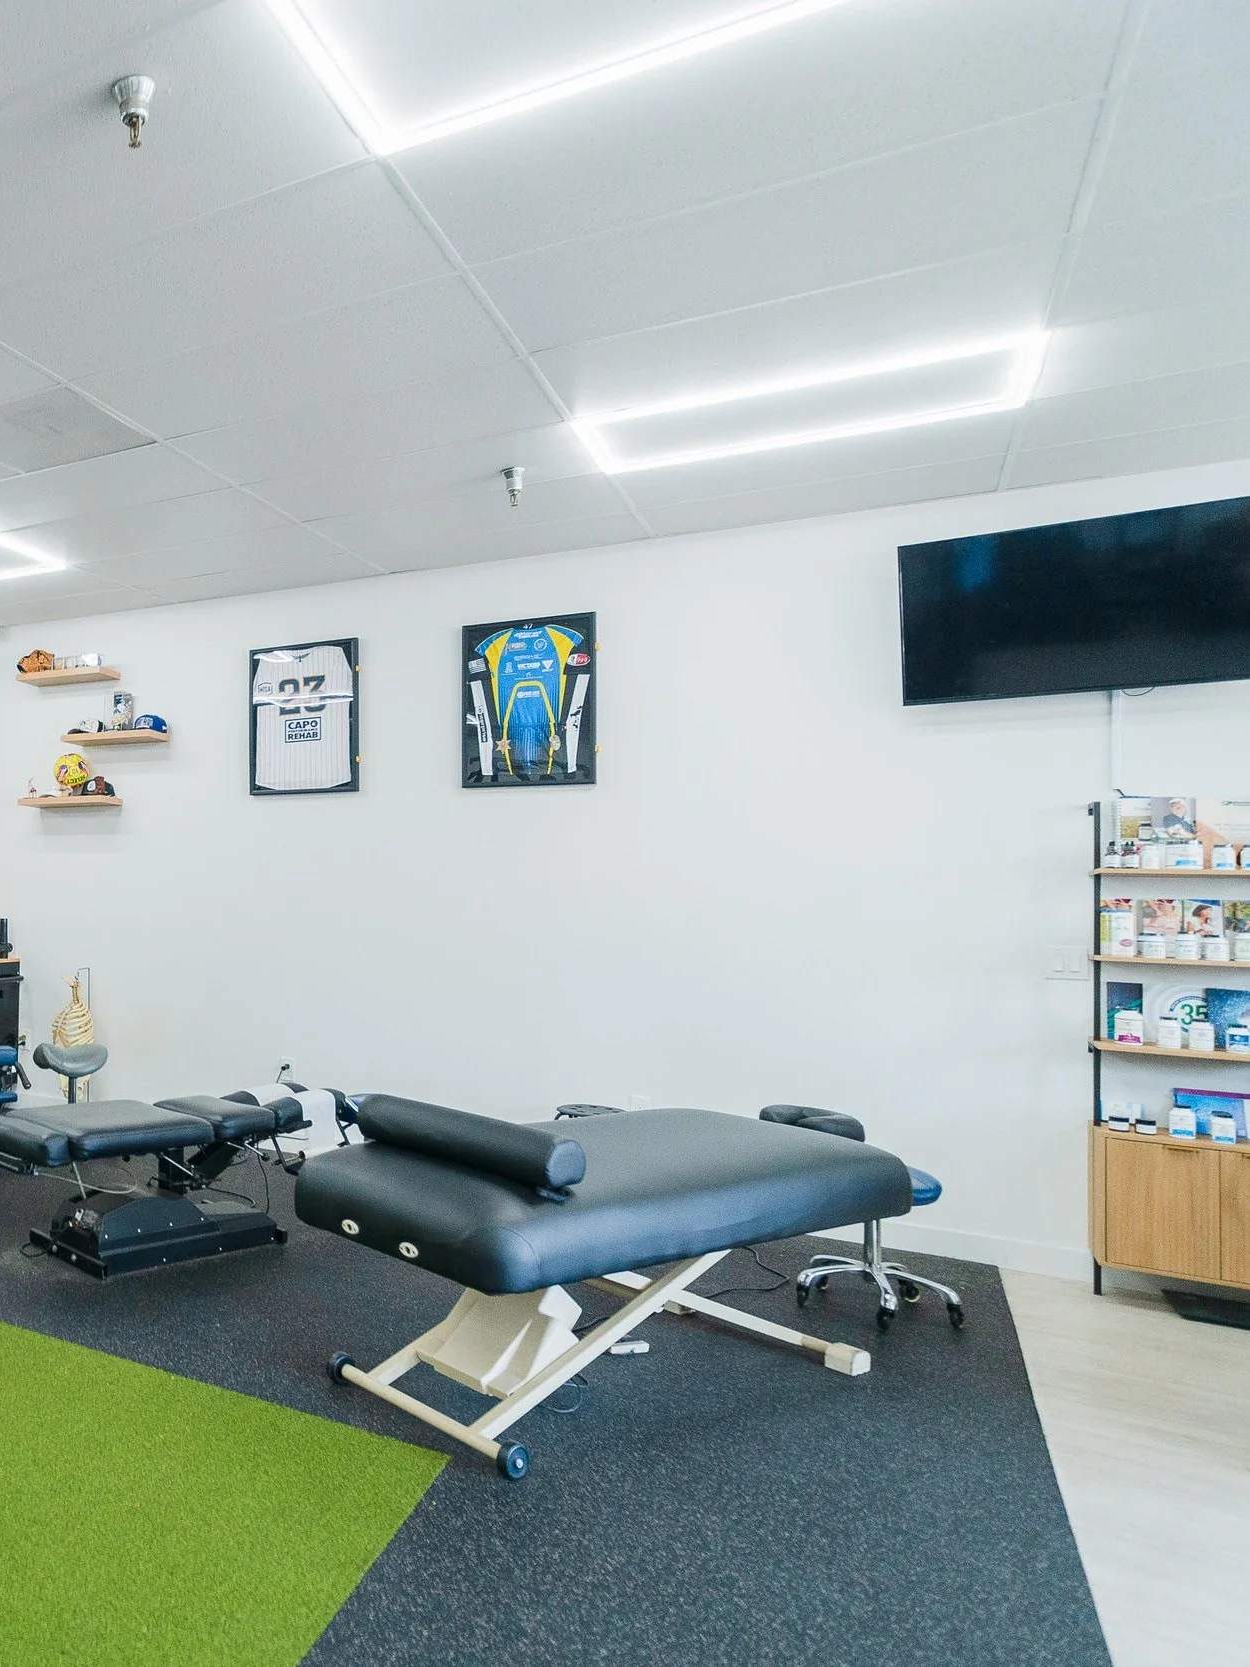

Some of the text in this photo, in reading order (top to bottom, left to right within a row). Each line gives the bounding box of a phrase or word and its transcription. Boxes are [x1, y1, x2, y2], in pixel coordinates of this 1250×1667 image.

[278, 674, 327, 716] 23
[288, 720, 318, 730] CAPO
[287, 731, 318, 740] REHAB
[66, 775, 86, 784] SELECT
[1180, 1003, 1208, 1025] 35
